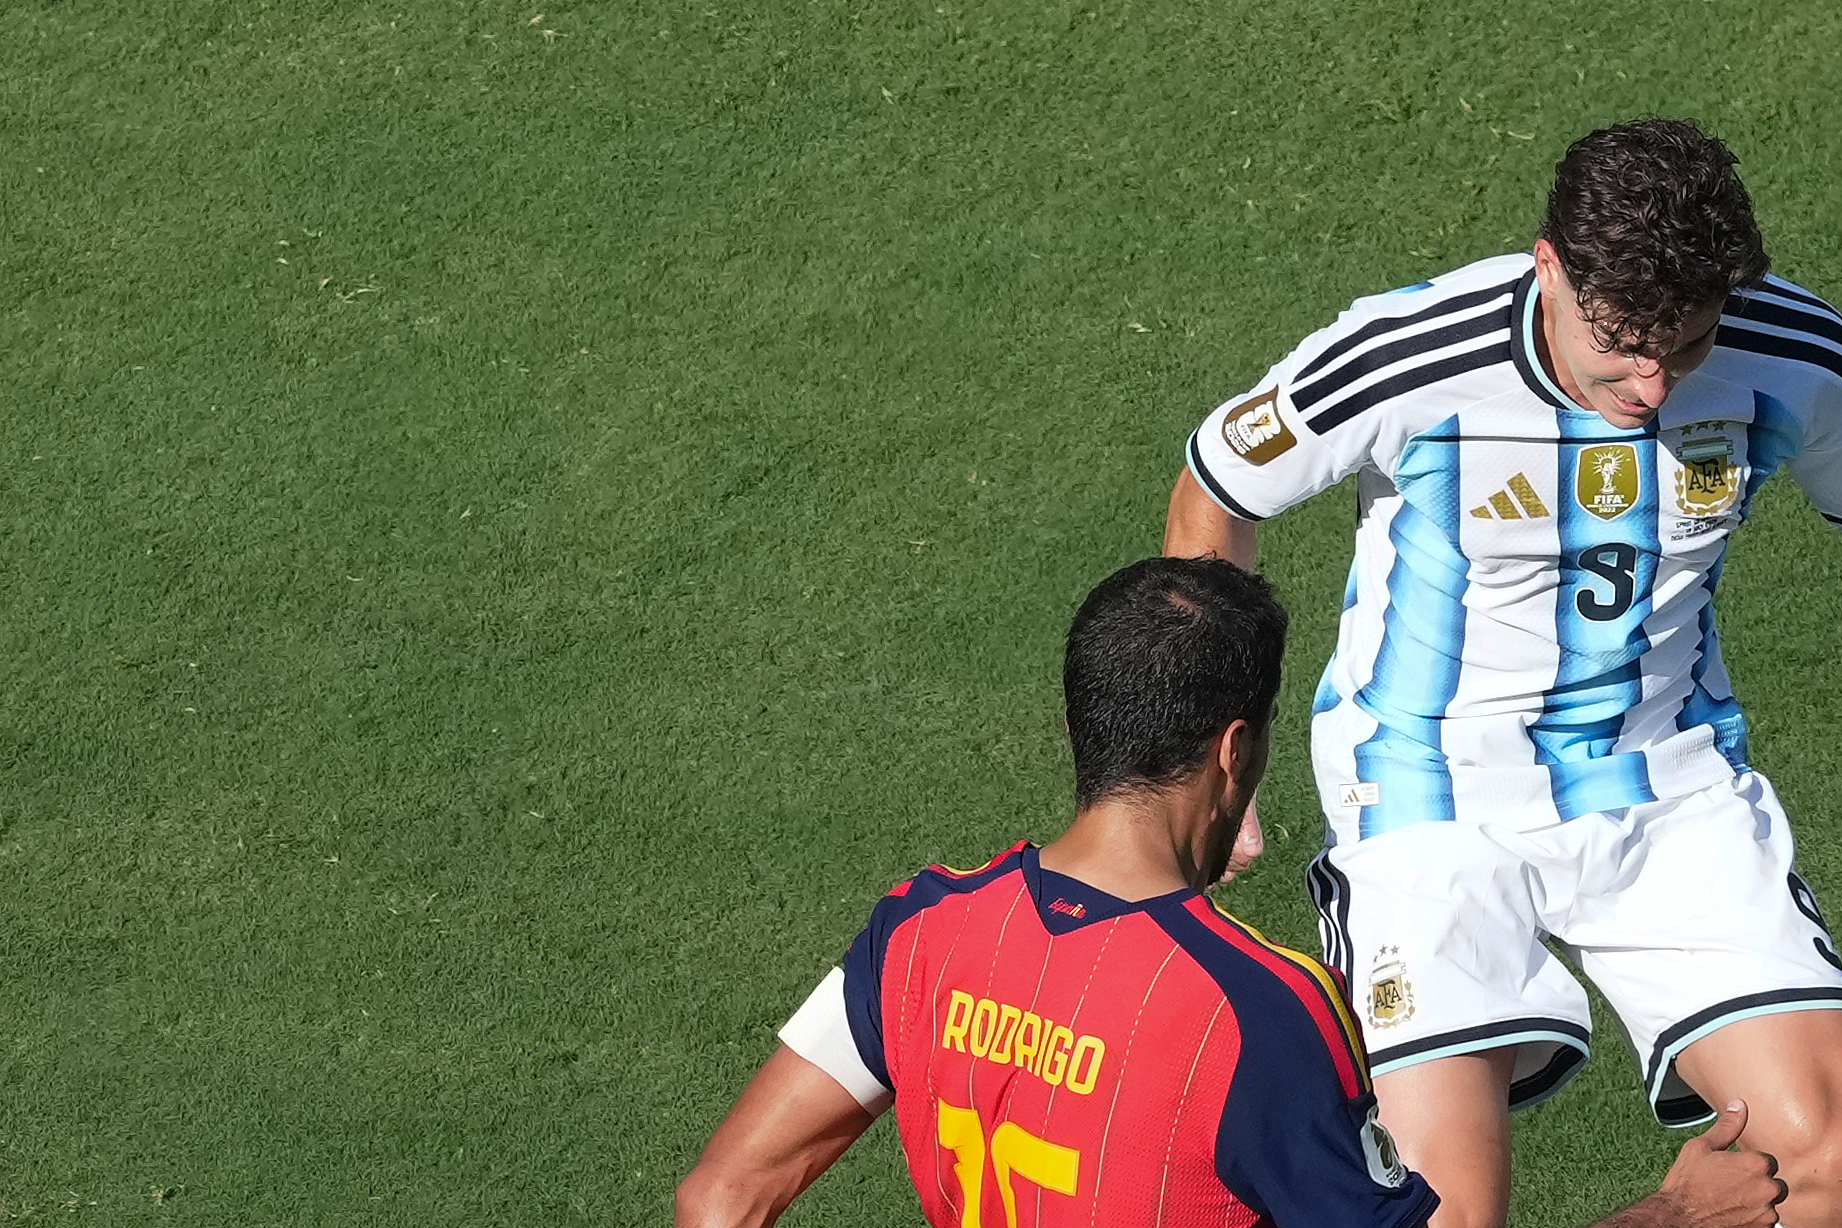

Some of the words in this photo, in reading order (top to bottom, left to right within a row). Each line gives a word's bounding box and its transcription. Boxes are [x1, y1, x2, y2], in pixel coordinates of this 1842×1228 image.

[1688, 458, 1726, 494] AFA
[1593, 494, 1624, 505] FIFA
[1576, 541, 1638, 622] 9
[1375, 979, 1403, 1010] AFA
[942, 989, 1106, 1095] RODRIGO
